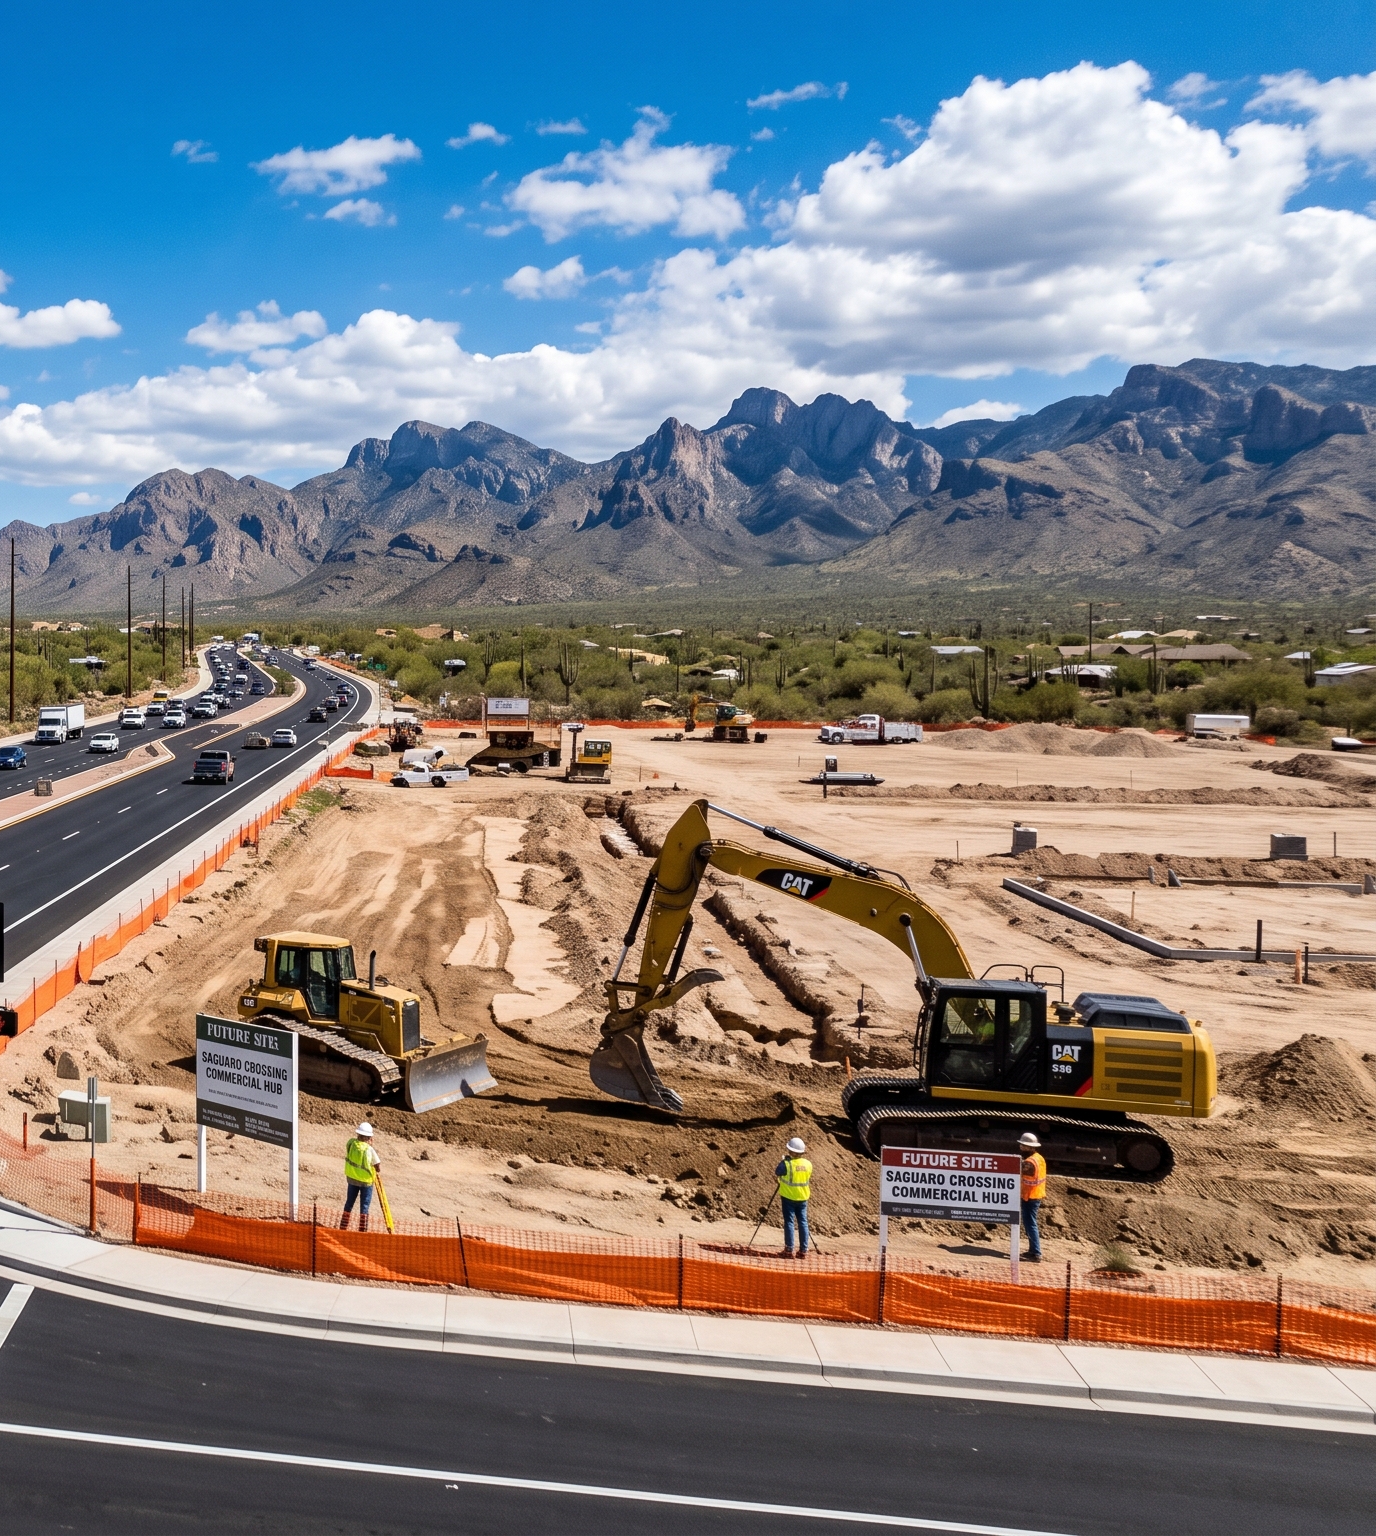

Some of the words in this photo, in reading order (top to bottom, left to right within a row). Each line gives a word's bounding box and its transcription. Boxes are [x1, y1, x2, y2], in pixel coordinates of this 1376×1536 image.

[781, 873, 813, 896] CAT
[207, 1022, 251, 1044] FUTURE
[202, 1051, 242, 1071] SAGUARO
[1052, 1044, 1082, 1062] CAT
[206, 1067, 262, 1091] COMMERCIAL
[264, 1080, 283, 1095] HUB
[902, 1152, 958, 1168] FUTURE
[961, 1156, 998, 1170] SITE:
[886, 1170, 946, 1186] SAGUARO
[949, 1174, 1015, 1190] CROSSING
[892, 1185, 978, 1203] COMMERCIAL
[982, 1191, 1009, 1205] HUB
